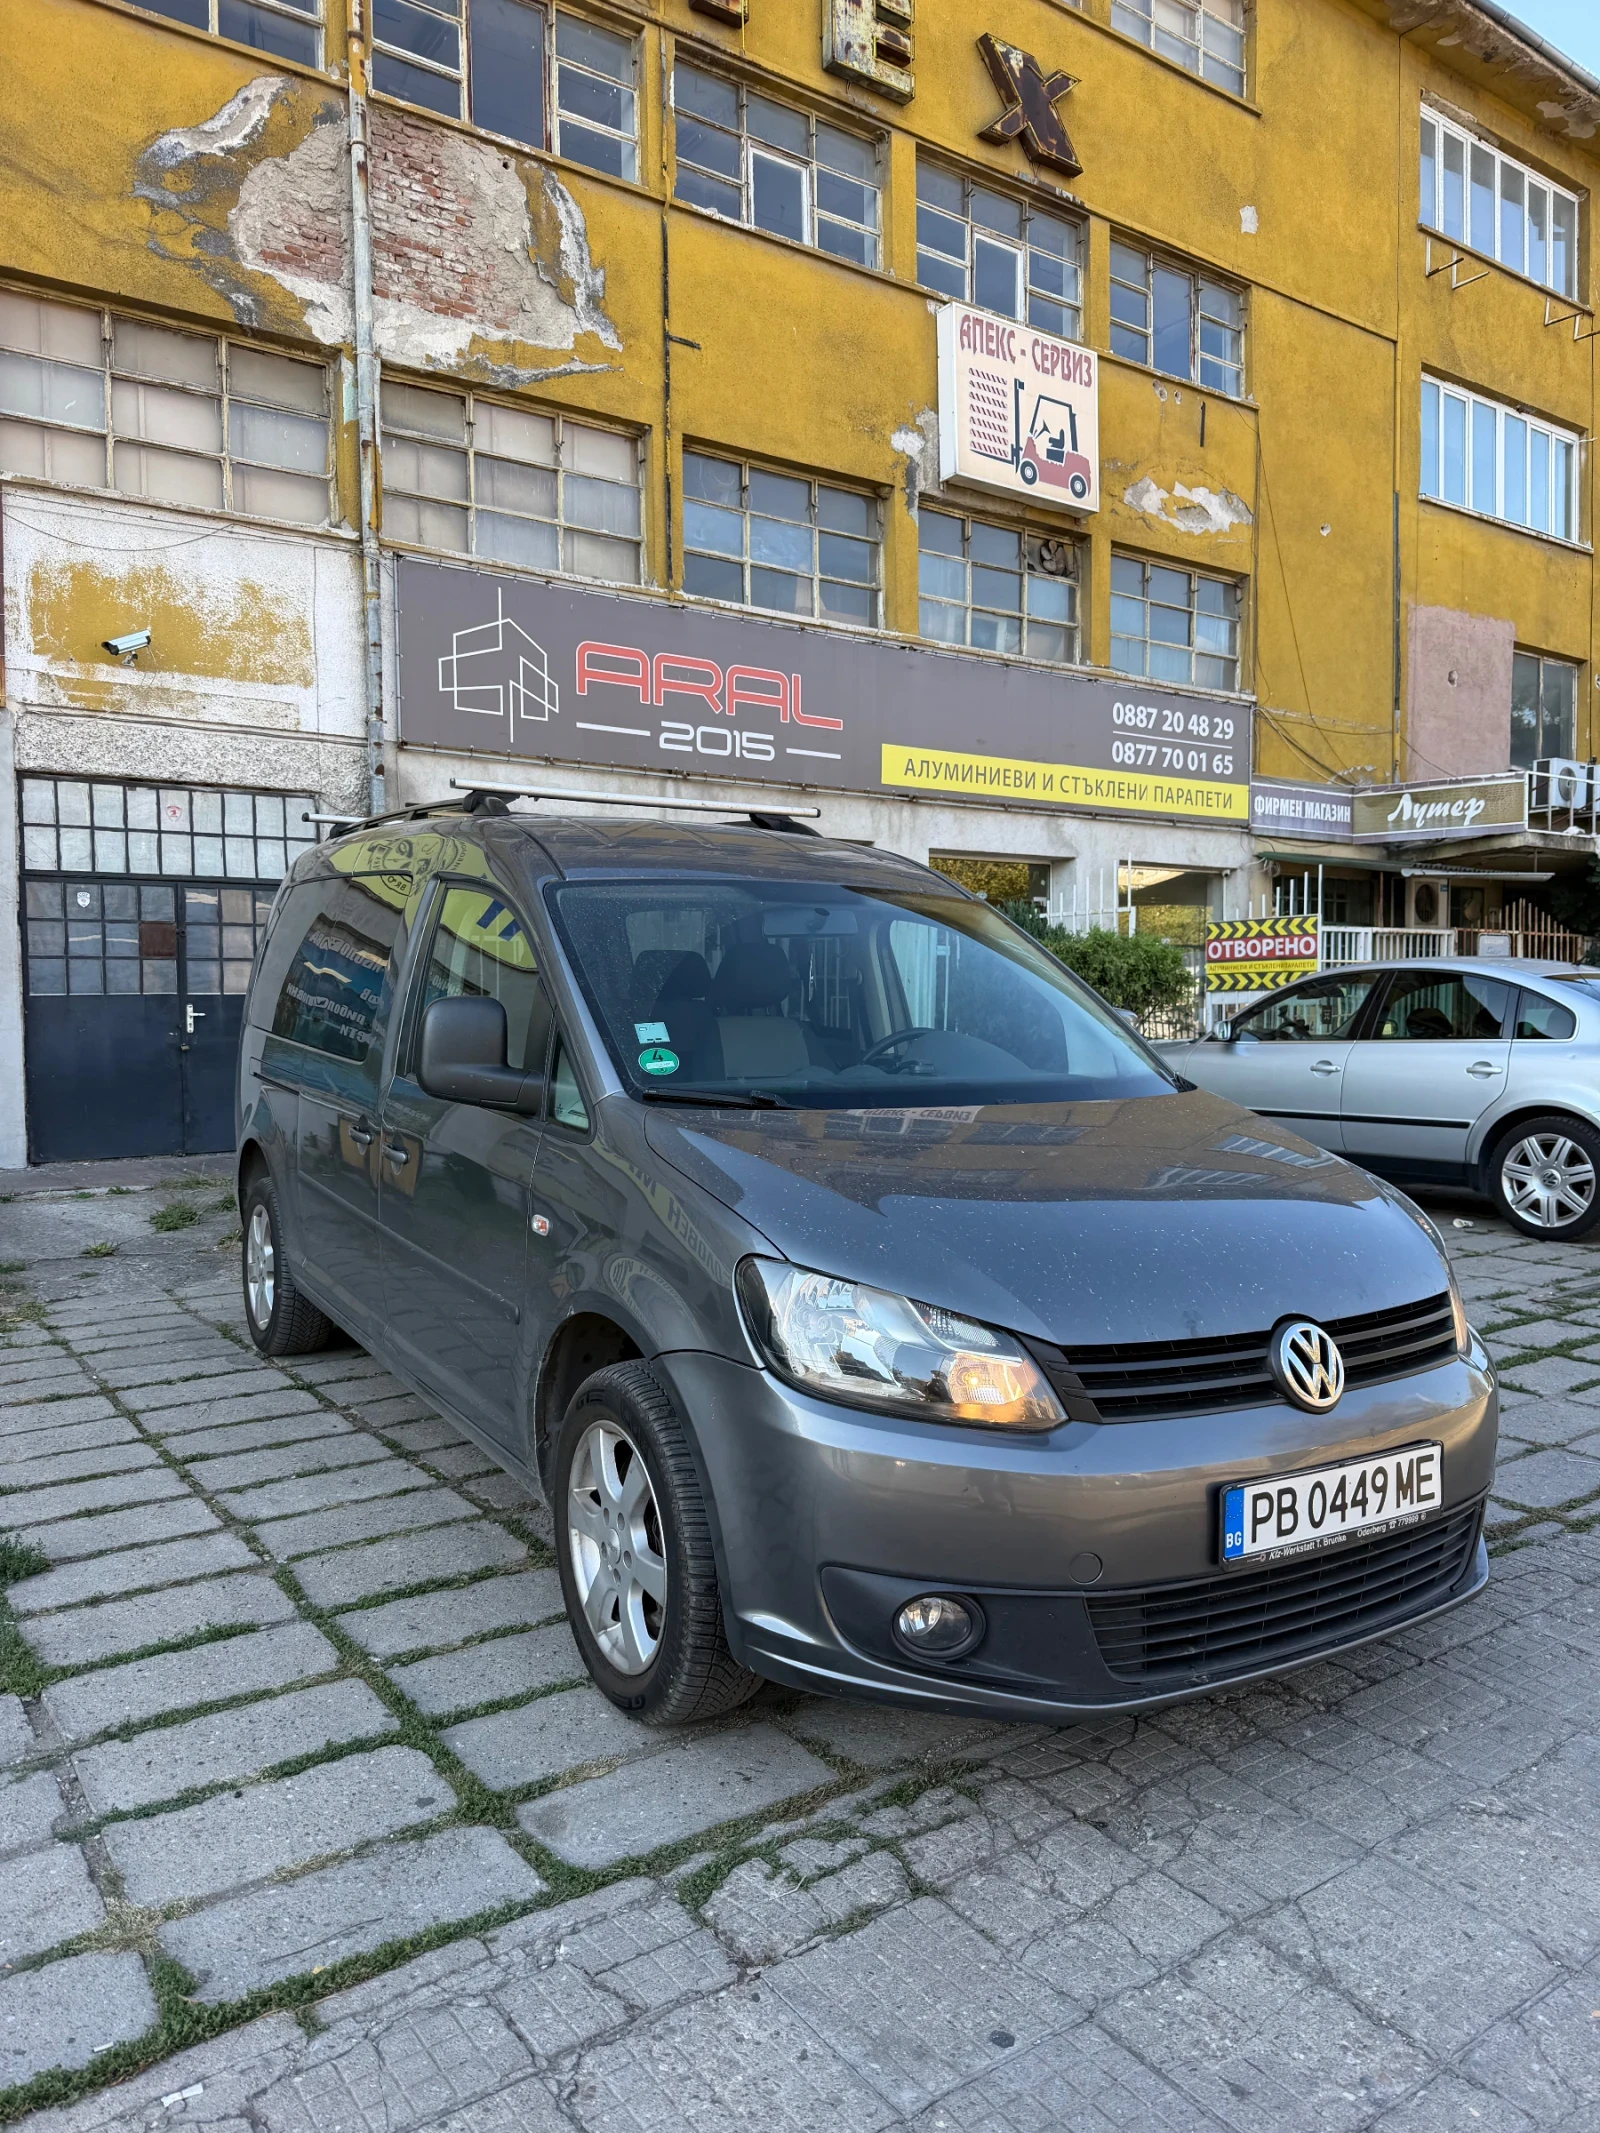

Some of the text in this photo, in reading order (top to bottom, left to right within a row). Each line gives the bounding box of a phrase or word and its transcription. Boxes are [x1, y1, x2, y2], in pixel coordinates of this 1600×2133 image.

[960, 314, 1017, 364] АПЕКС
[1031, 338, 1093, 388] СЕРВИЗ
[576, 640, 843, 730] ARAL
[1112, 702, 1235, 740] 0887 20 48 29
[659, 720, 775, 761] 2015
[1111, 741, 1234, 775] 0877 70 01 65
[904, 758, 1233, 810] АЛУМИНИЕВИ И СТЪКЛЕНИ ПАРАПЕТИ
[1254, 794, 1351, 823] ФИРМЕН МАГАЗИН
[1387, 793, 1486, 828] Лутер
[1207, 936, 1316, 959] ОТВОРЕНО
[652, 1049, 664, 1061] 4
[1251, 1453, 1435, 1544] PB 0449 ME
[1226, 1531, 1242, 1549] BG
[1357, 1524, 1387, 1538] Oderberg
